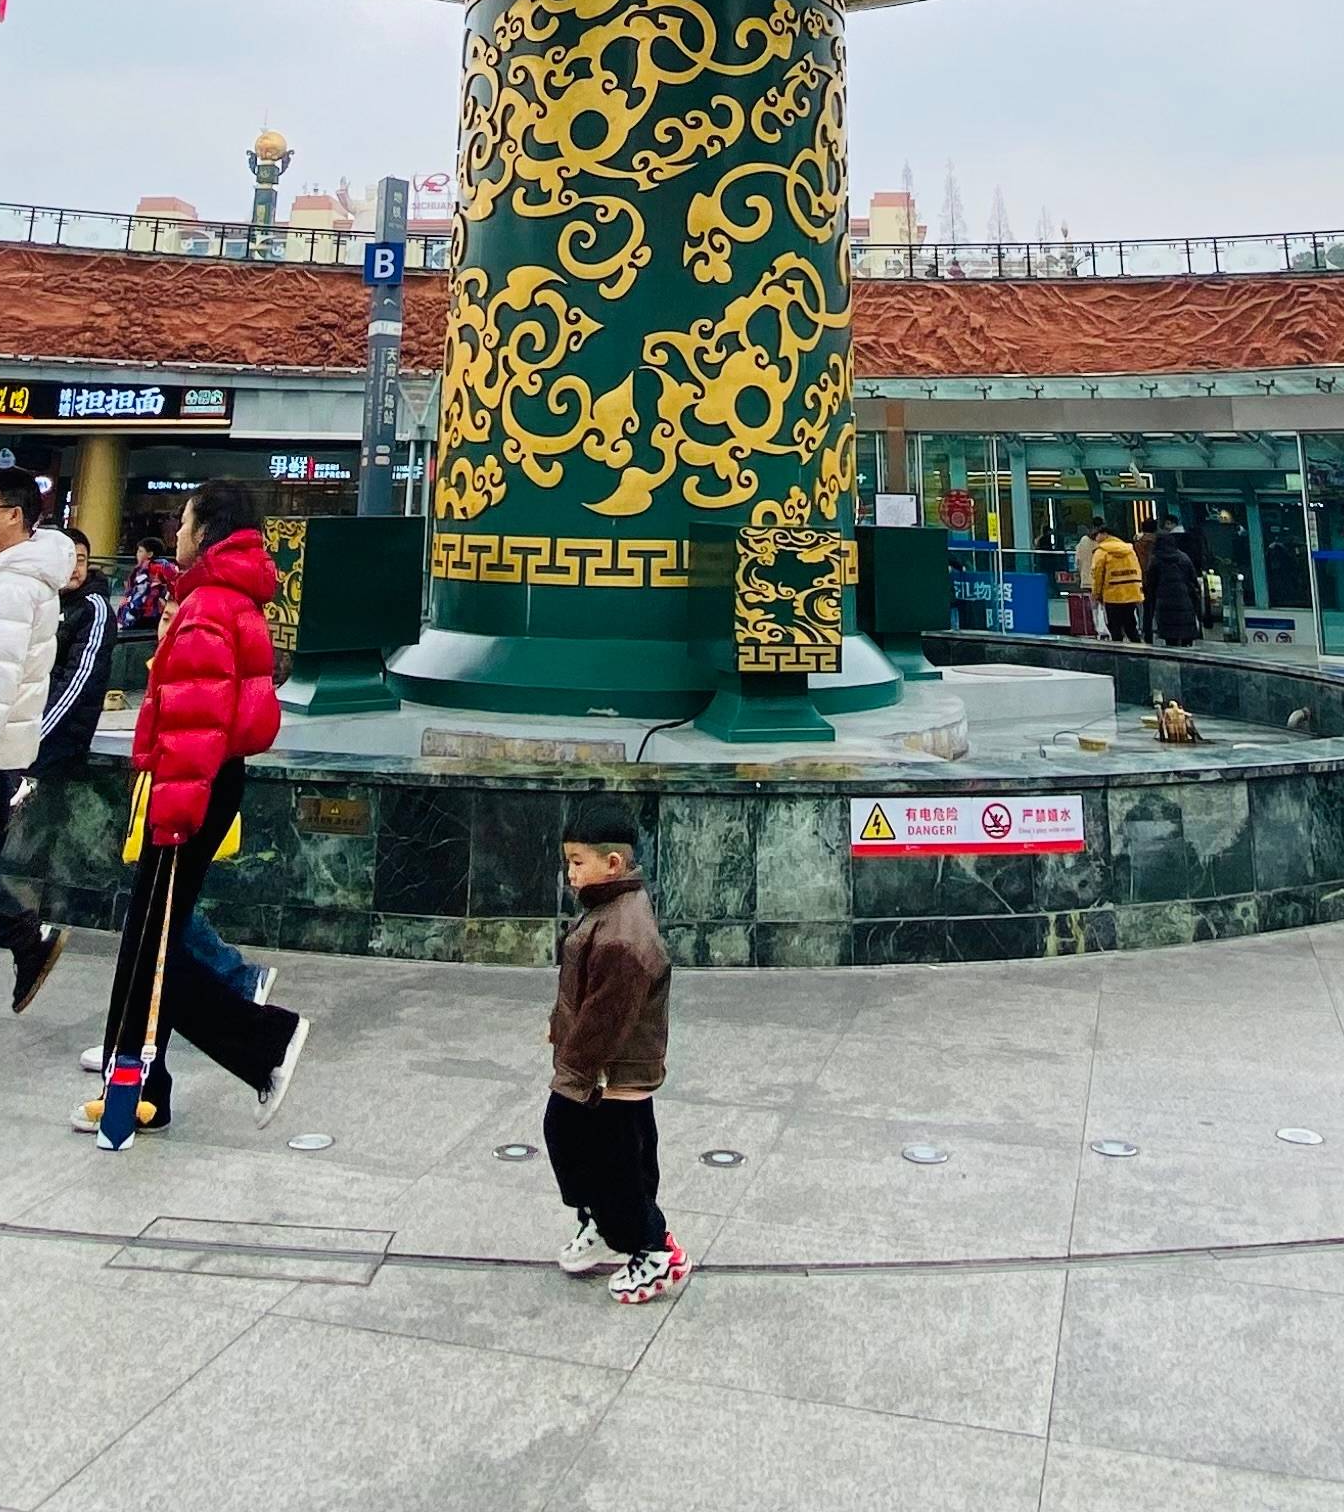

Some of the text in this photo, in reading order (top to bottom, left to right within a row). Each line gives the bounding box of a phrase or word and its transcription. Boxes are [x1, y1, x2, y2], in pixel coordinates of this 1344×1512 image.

[374, 248, 395, 279] B
[905, 806, 959, 823] 有电危险
[907, 824, 957, 836] DANGER!
